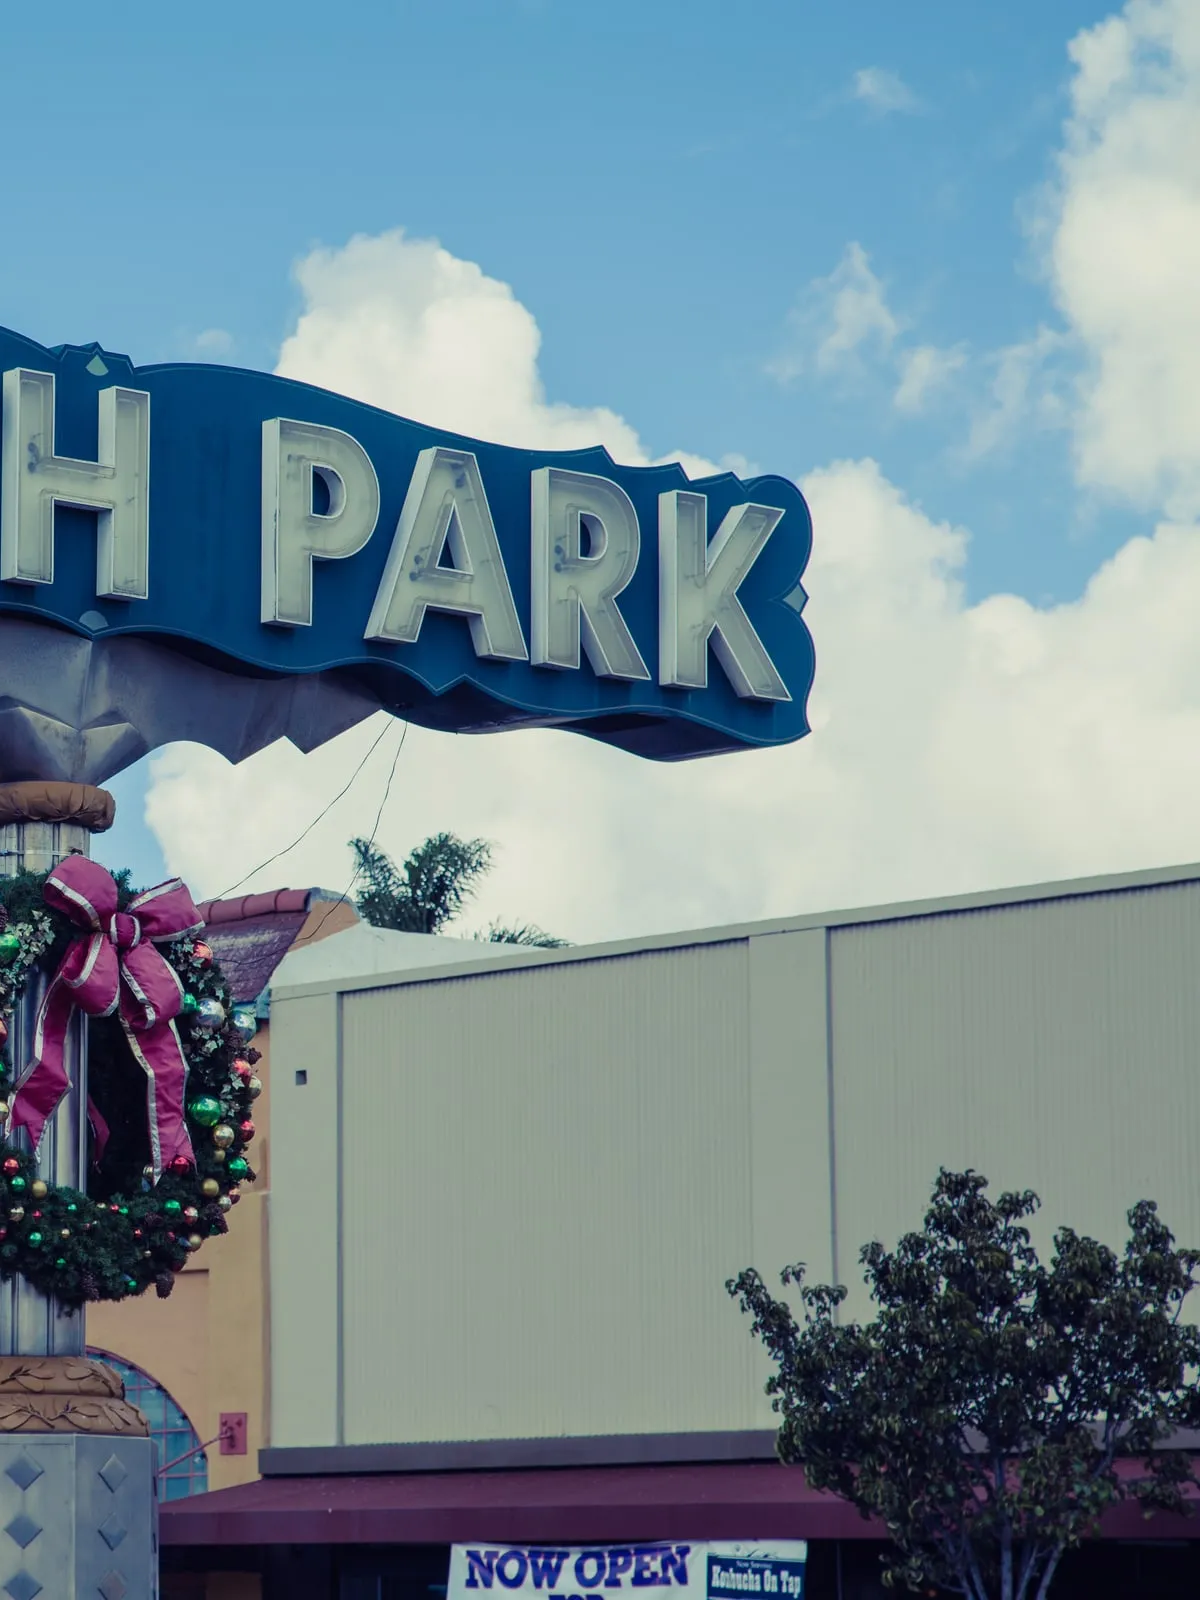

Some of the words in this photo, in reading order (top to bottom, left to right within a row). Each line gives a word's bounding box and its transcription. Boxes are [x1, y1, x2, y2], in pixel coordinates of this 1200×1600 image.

[261, 417, 793, 702] PARK
[465, 1549, 570, 1589] NOW
[574, 1545, 691, 1589] OPEN
[763, 1569, 778, 1593] On
[780, 1570, 801, 1599] Tap
